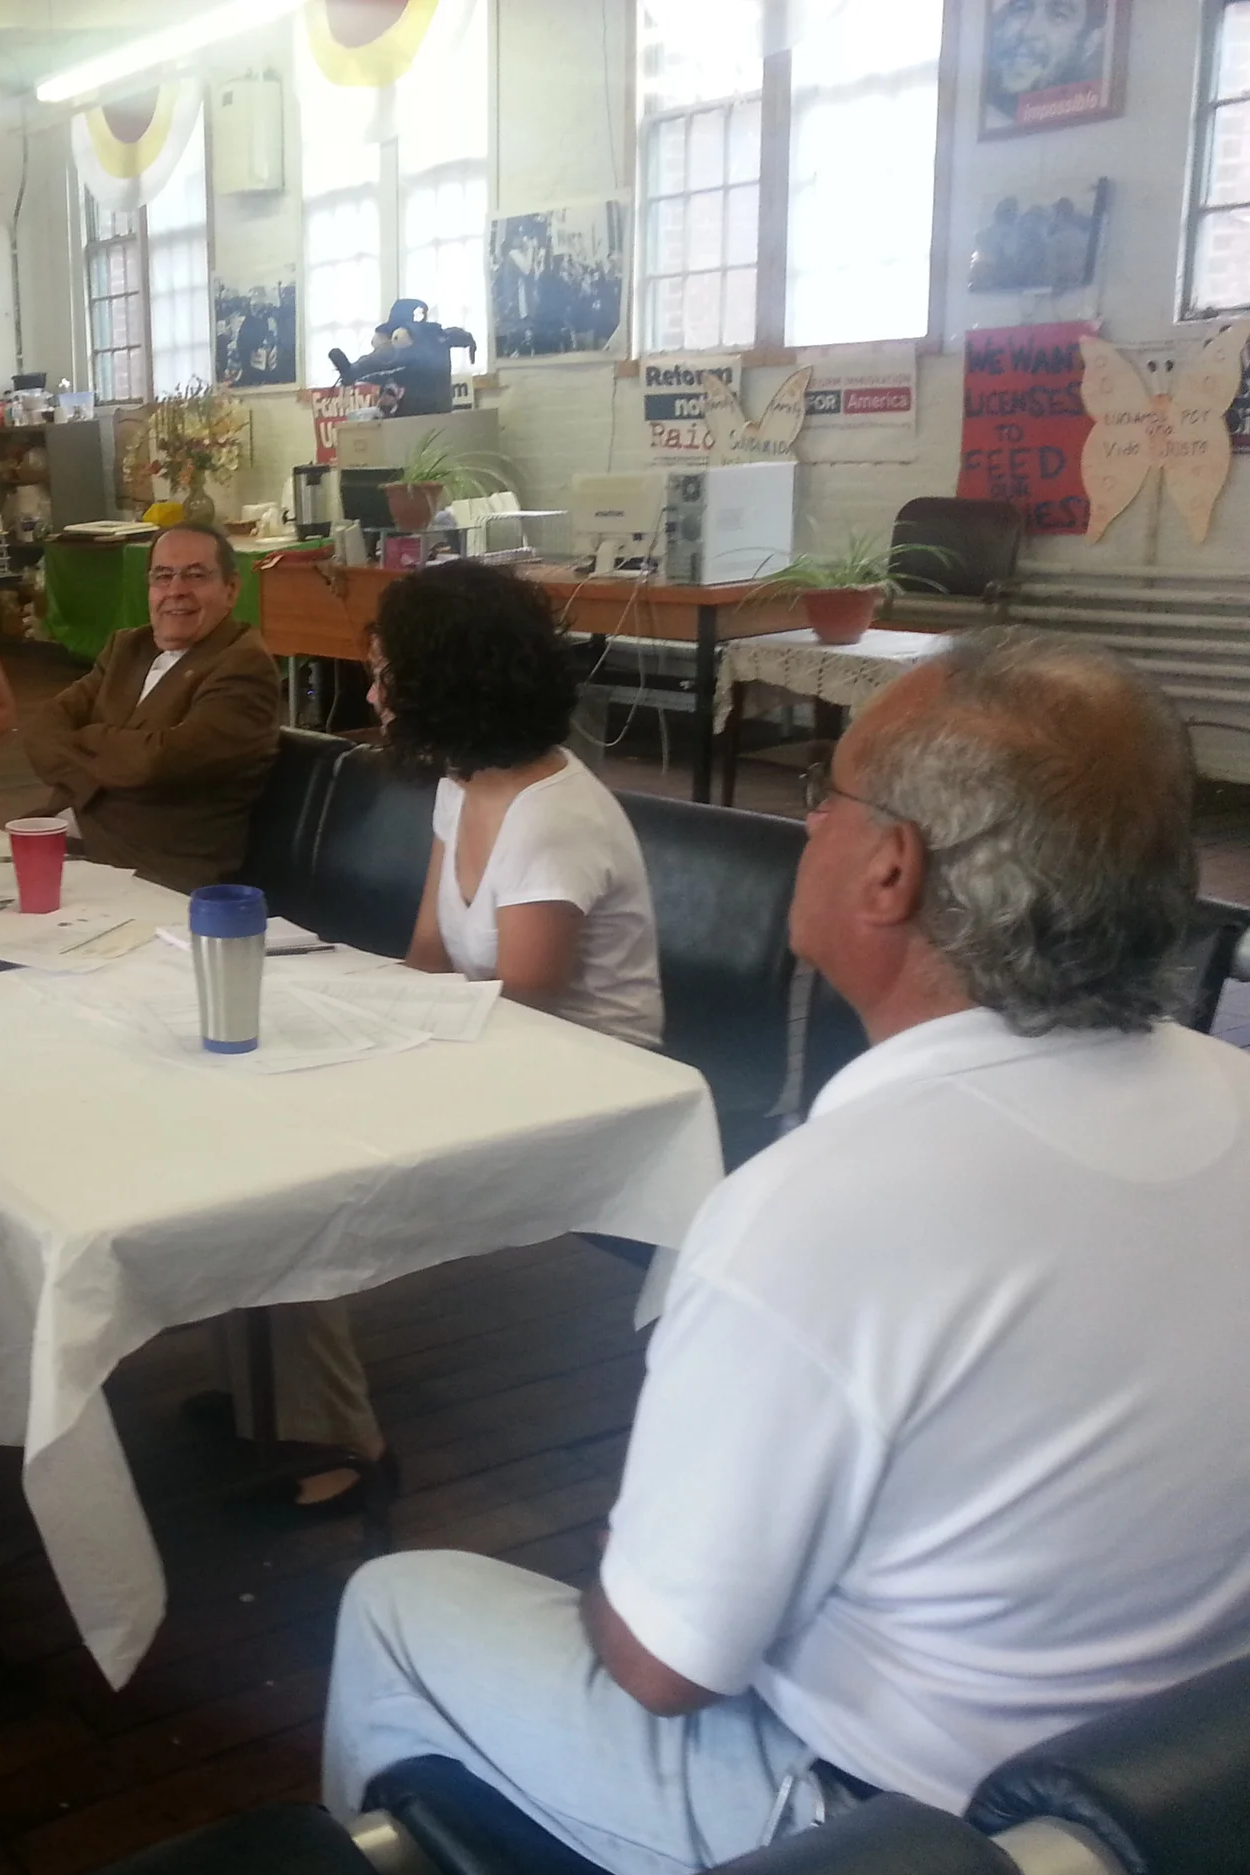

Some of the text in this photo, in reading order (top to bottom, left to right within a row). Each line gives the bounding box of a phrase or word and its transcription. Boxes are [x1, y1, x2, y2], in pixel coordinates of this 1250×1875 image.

[965, 336, 1004, 374] WE
[847, 391, 908, 409] America
[995, 424, 1024, 443] TO
[965, 446, 1067, 482] FEED
